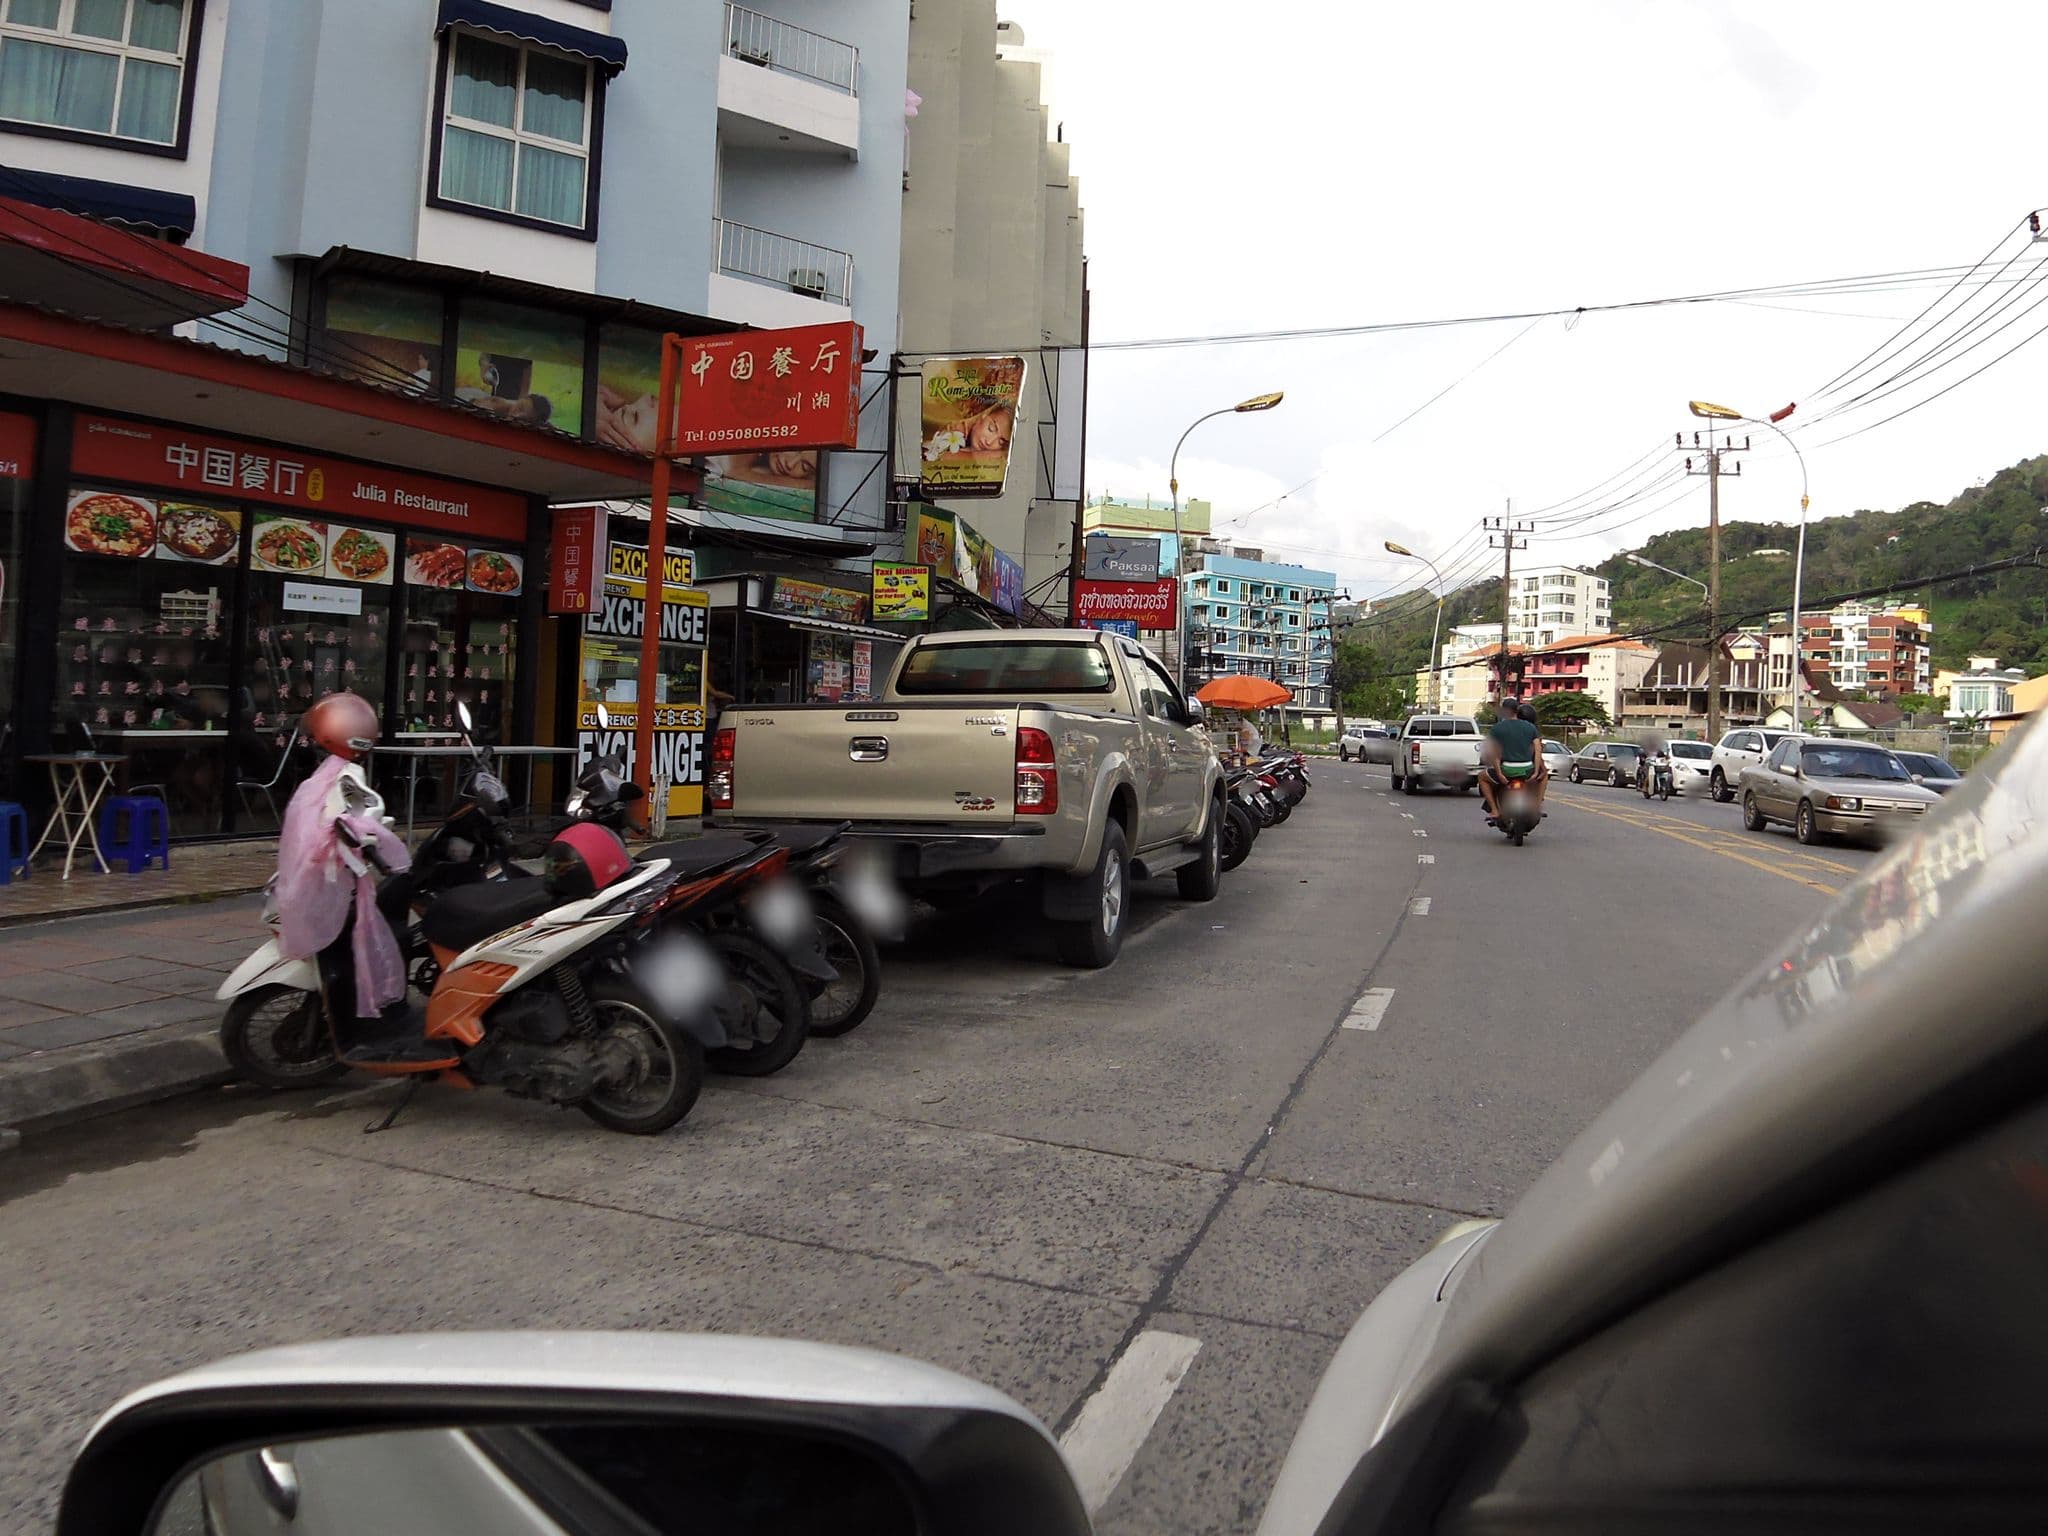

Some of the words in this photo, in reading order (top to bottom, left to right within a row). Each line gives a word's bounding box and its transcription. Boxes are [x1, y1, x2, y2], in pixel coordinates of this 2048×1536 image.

[690, 339, 841, 387] 中国餐厅
[786, 391, 831, 413] 川湘
[164, 442, 305, 497] 中国餐厅
[352, 482, 386, 503] Julia
[393, 489, 469, 517] Restaurant
[562, 524, 582, 609] 中国餐厅
[611, 547, 691, 583] EXCHNGE
[875, 568, 893, 576] Taxi
[896, 567, 927, 575] Minibus
[1110, 560, 1155, 572] Paksaa
[965, 714, 1008, 726] HILUX
